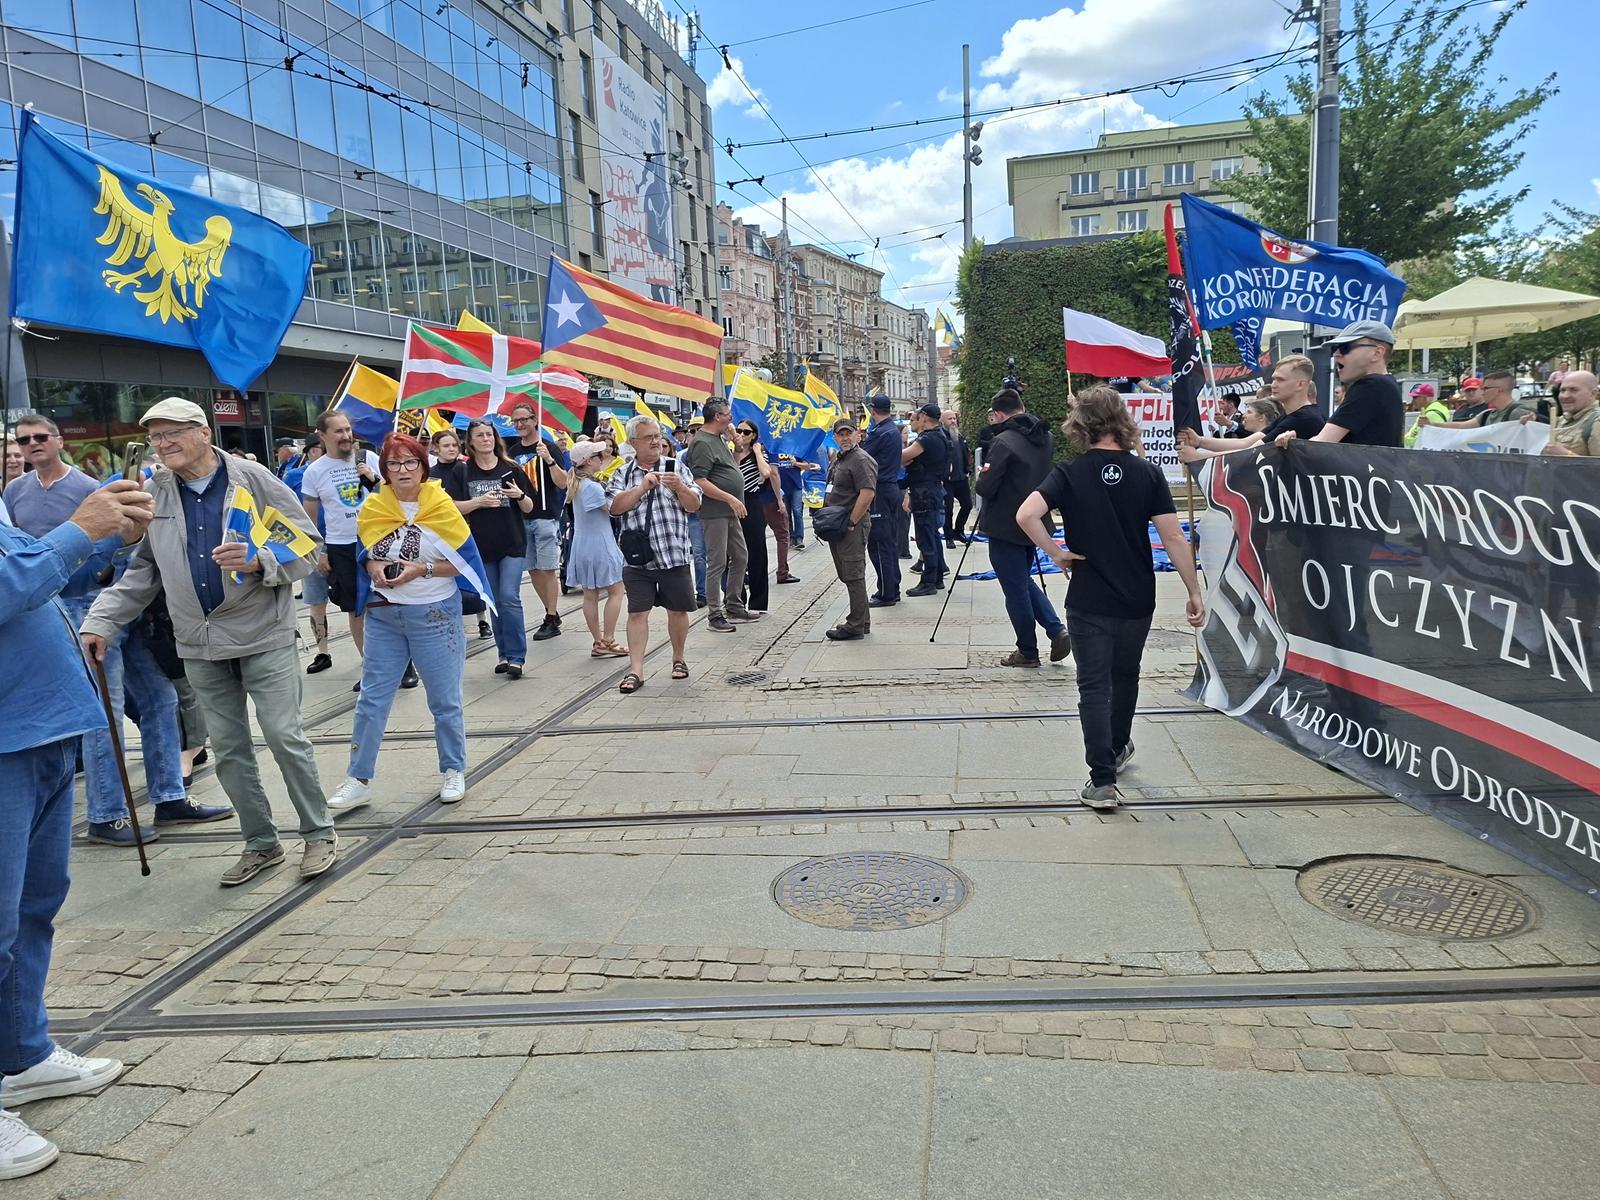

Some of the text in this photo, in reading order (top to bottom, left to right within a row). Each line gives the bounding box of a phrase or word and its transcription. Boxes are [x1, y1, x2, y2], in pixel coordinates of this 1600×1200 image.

[618, 76, 636, 102] Radio
[619, 99, 647, 132] Katowice
[1202, 266, 1389, 307] KONFEDERACJA
[1206, 288, 1275, 320] KORONY
[1280, 291, 1388, 323] POLSKIEJ
[1256, 452, 1400, 535] ŚMIERĆ
[1267, 686, 1421, 778] NARODOWE
